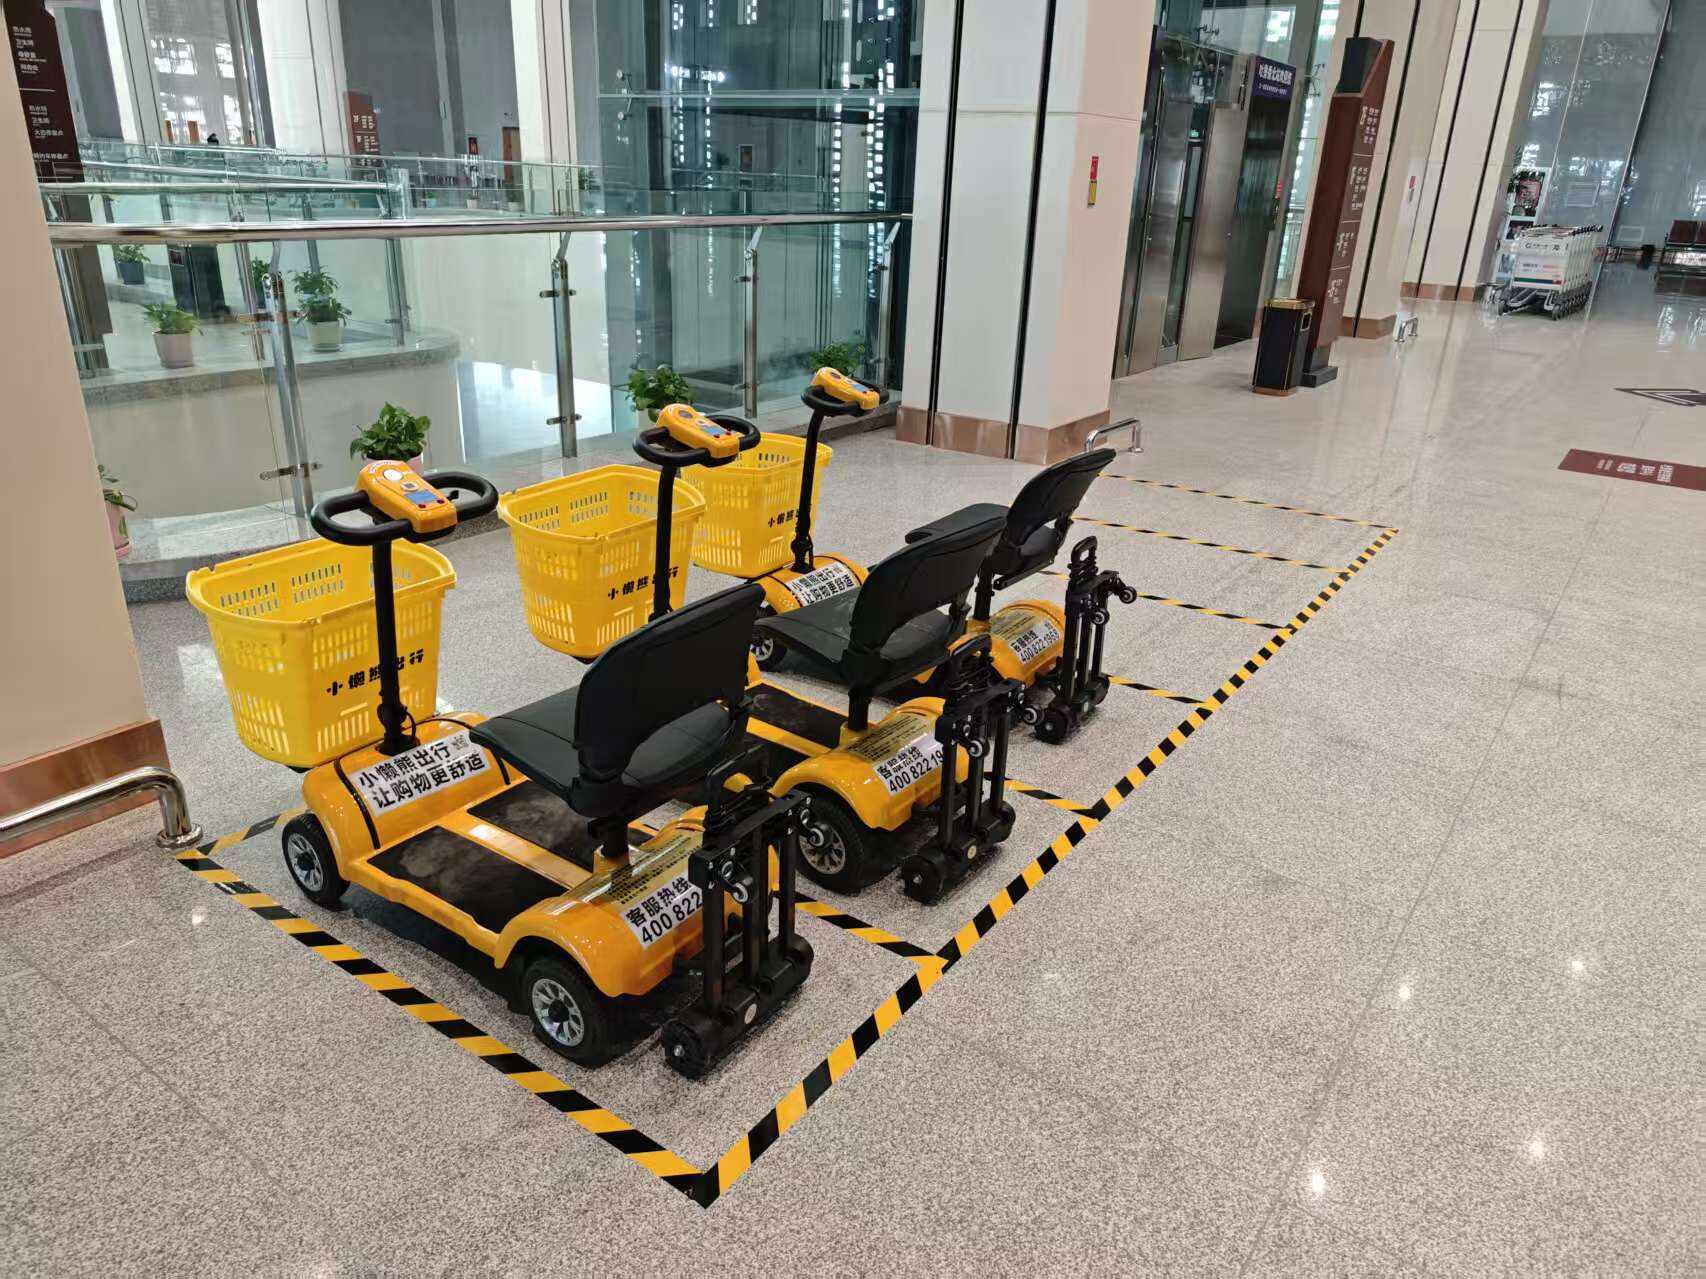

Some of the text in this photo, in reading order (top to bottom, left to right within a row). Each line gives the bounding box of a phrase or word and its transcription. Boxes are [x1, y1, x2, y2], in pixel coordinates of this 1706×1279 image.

[359, 741, 451, 789] 小懒熊出行
[372, 752, 486, 810] 让购物更舒适
[876, 745, 923, 780] 客服热线
[889, 771, 911, 792] 400
[910, 757, 932, 779] 822
[625, 876, 692, 927] 客服热线
[641, 891, 704, 943] 400 822
